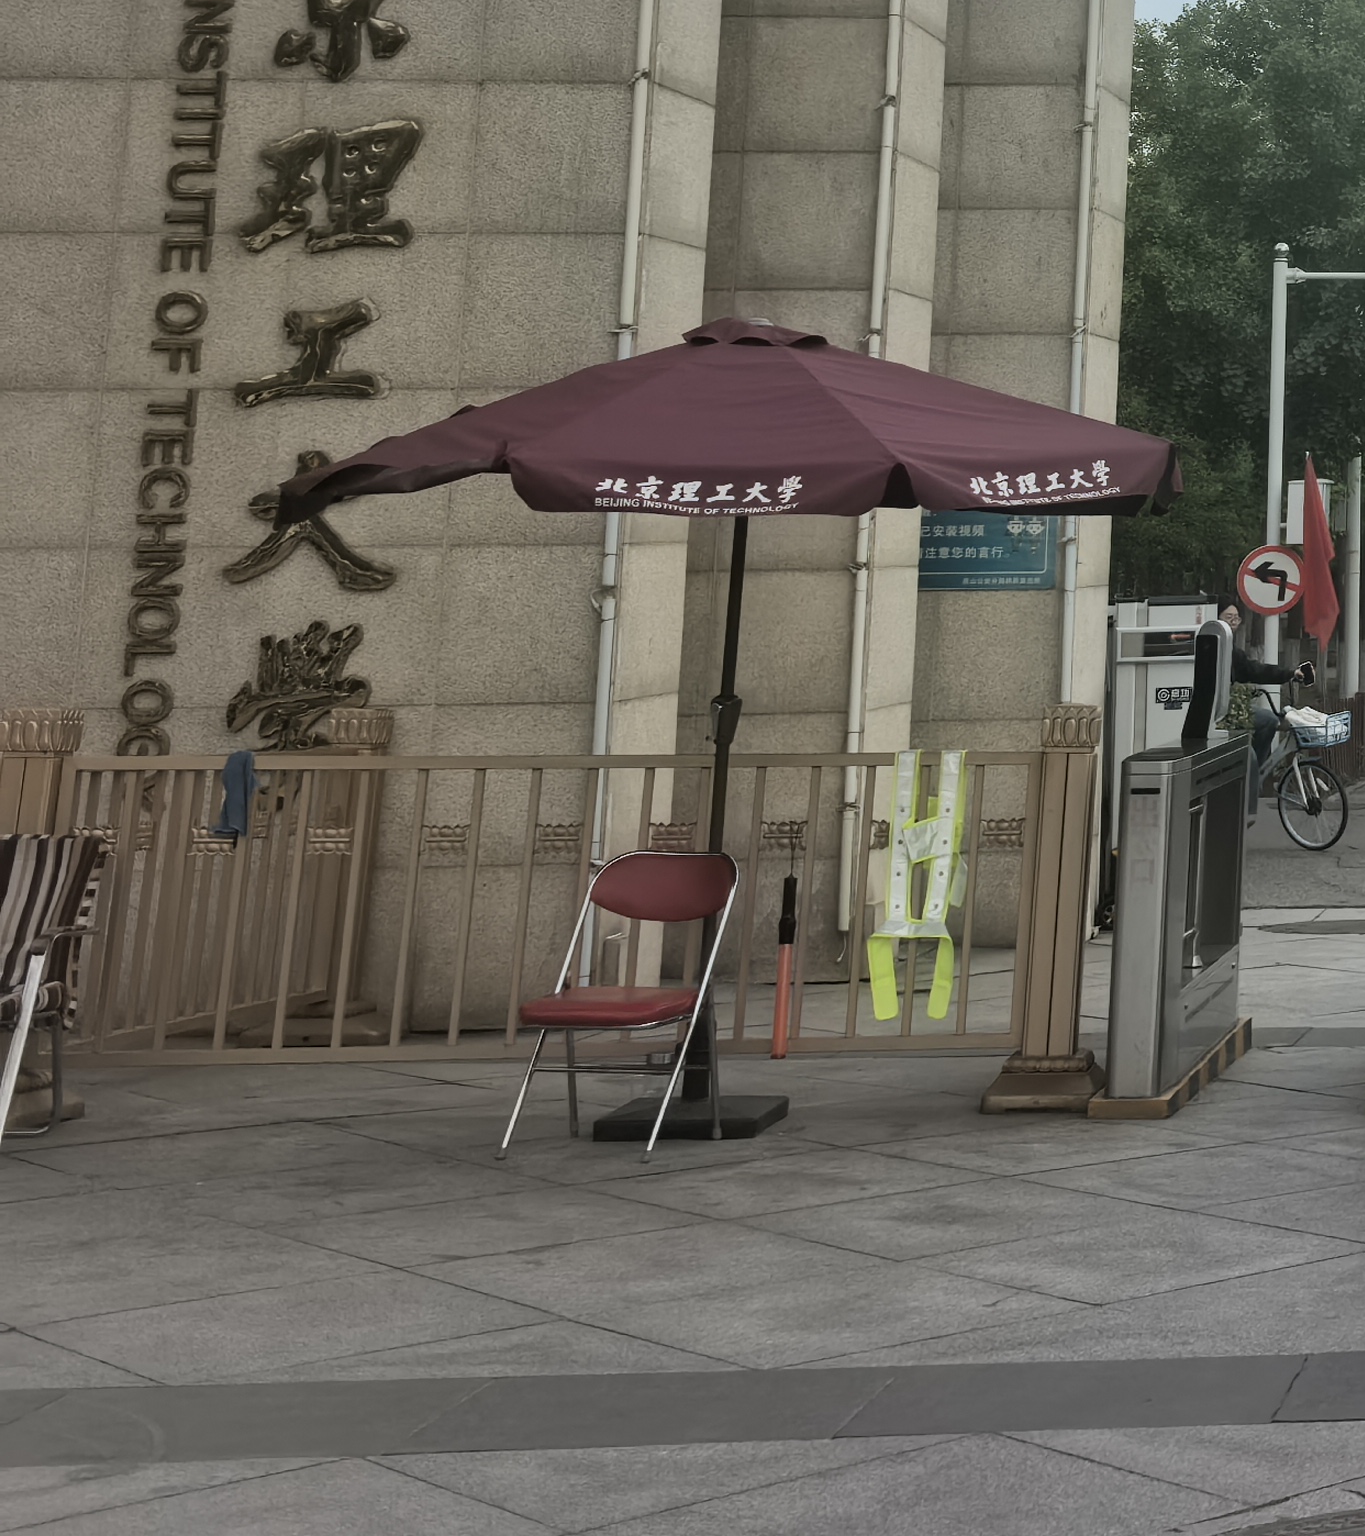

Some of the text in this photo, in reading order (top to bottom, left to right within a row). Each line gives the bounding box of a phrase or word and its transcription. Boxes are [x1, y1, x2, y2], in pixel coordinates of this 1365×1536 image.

[150, 290, 209, 374] OF
[594, 497, 640, 508] BEIJING
[642, 499, 700, 514] INSTITUTE
[722, 501, 799, 515] TECHNOLOGY
[920, 546, 1010, 560] 注意您的言行。
